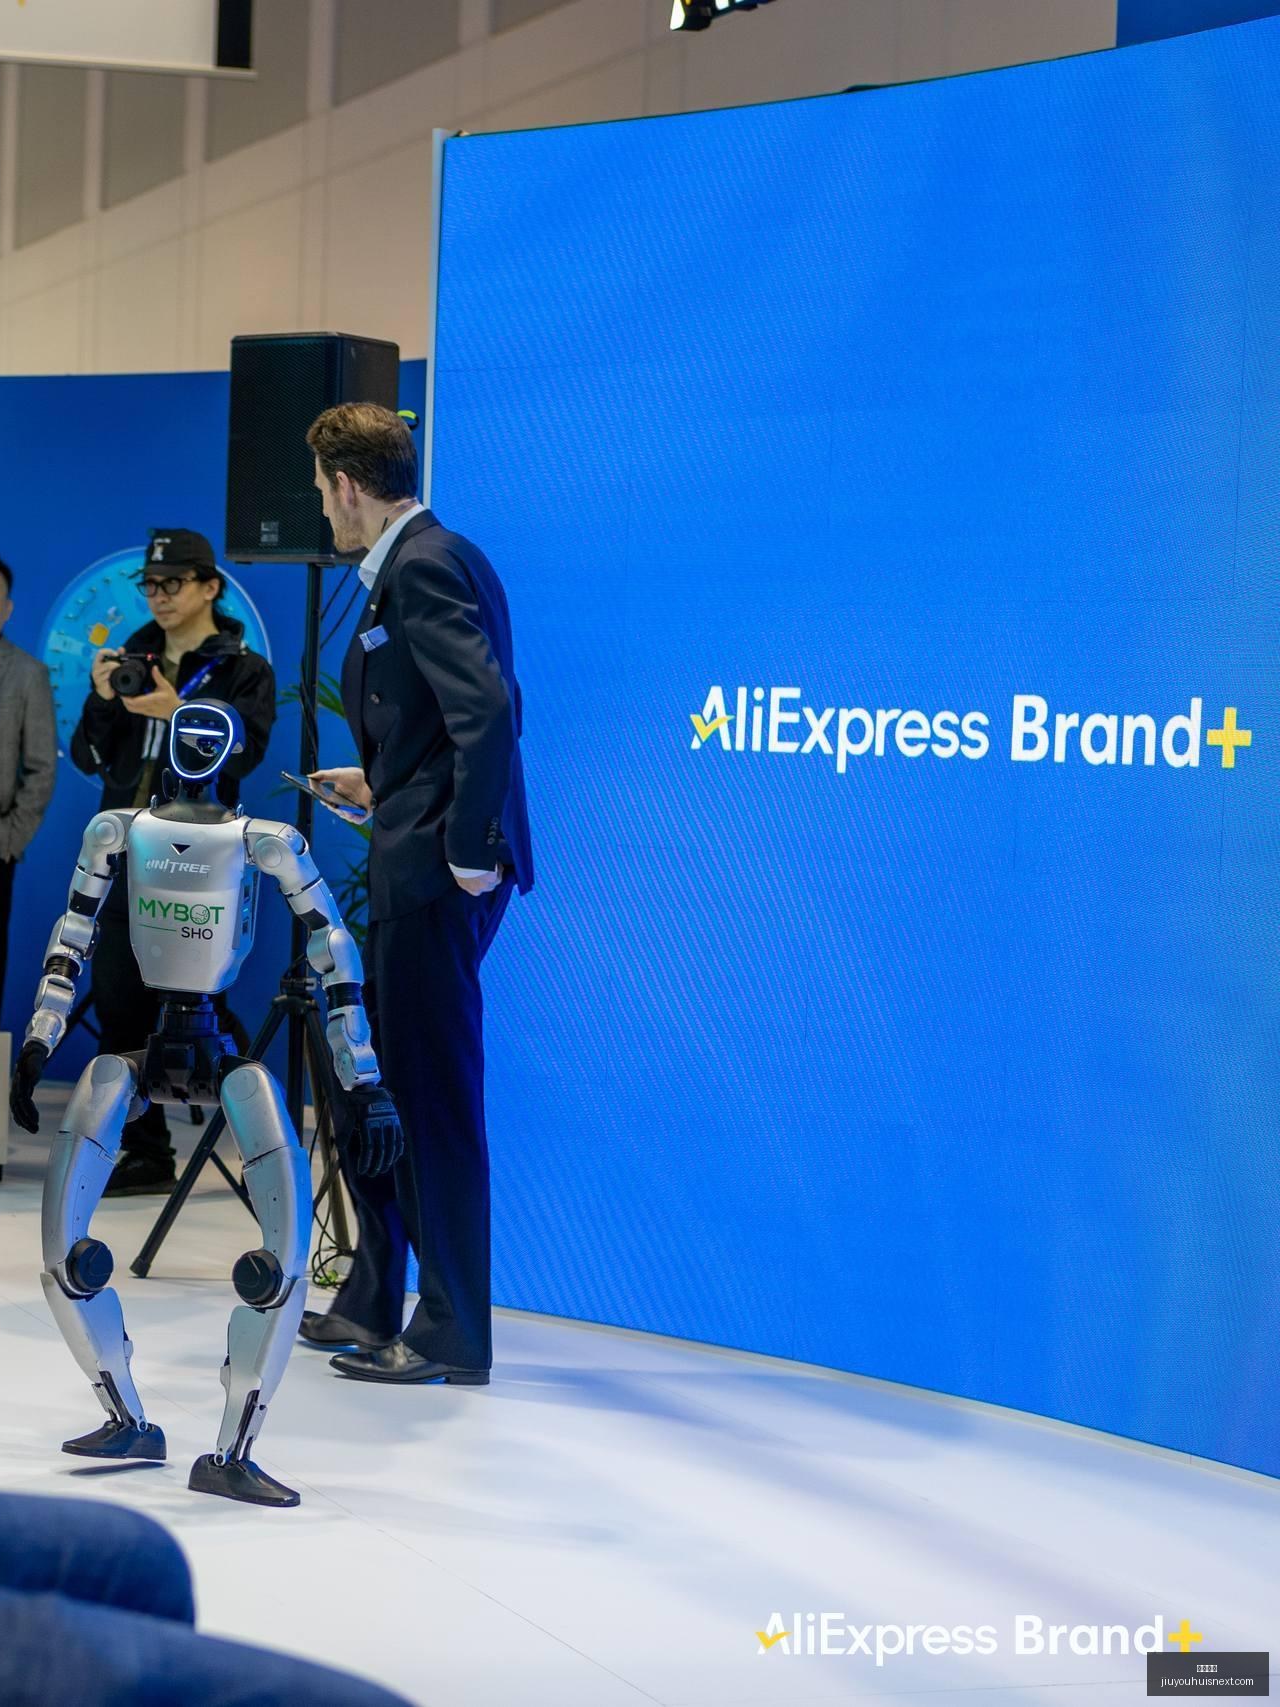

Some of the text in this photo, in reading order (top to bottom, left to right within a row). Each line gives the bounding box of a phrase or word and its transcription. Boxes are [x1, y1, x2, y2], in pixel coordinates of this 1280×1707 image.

[690, 685, 990, 774] AliExpress
[138, 896, 225, 925] MYBOT
[181, 927, 213, 940] SHO
